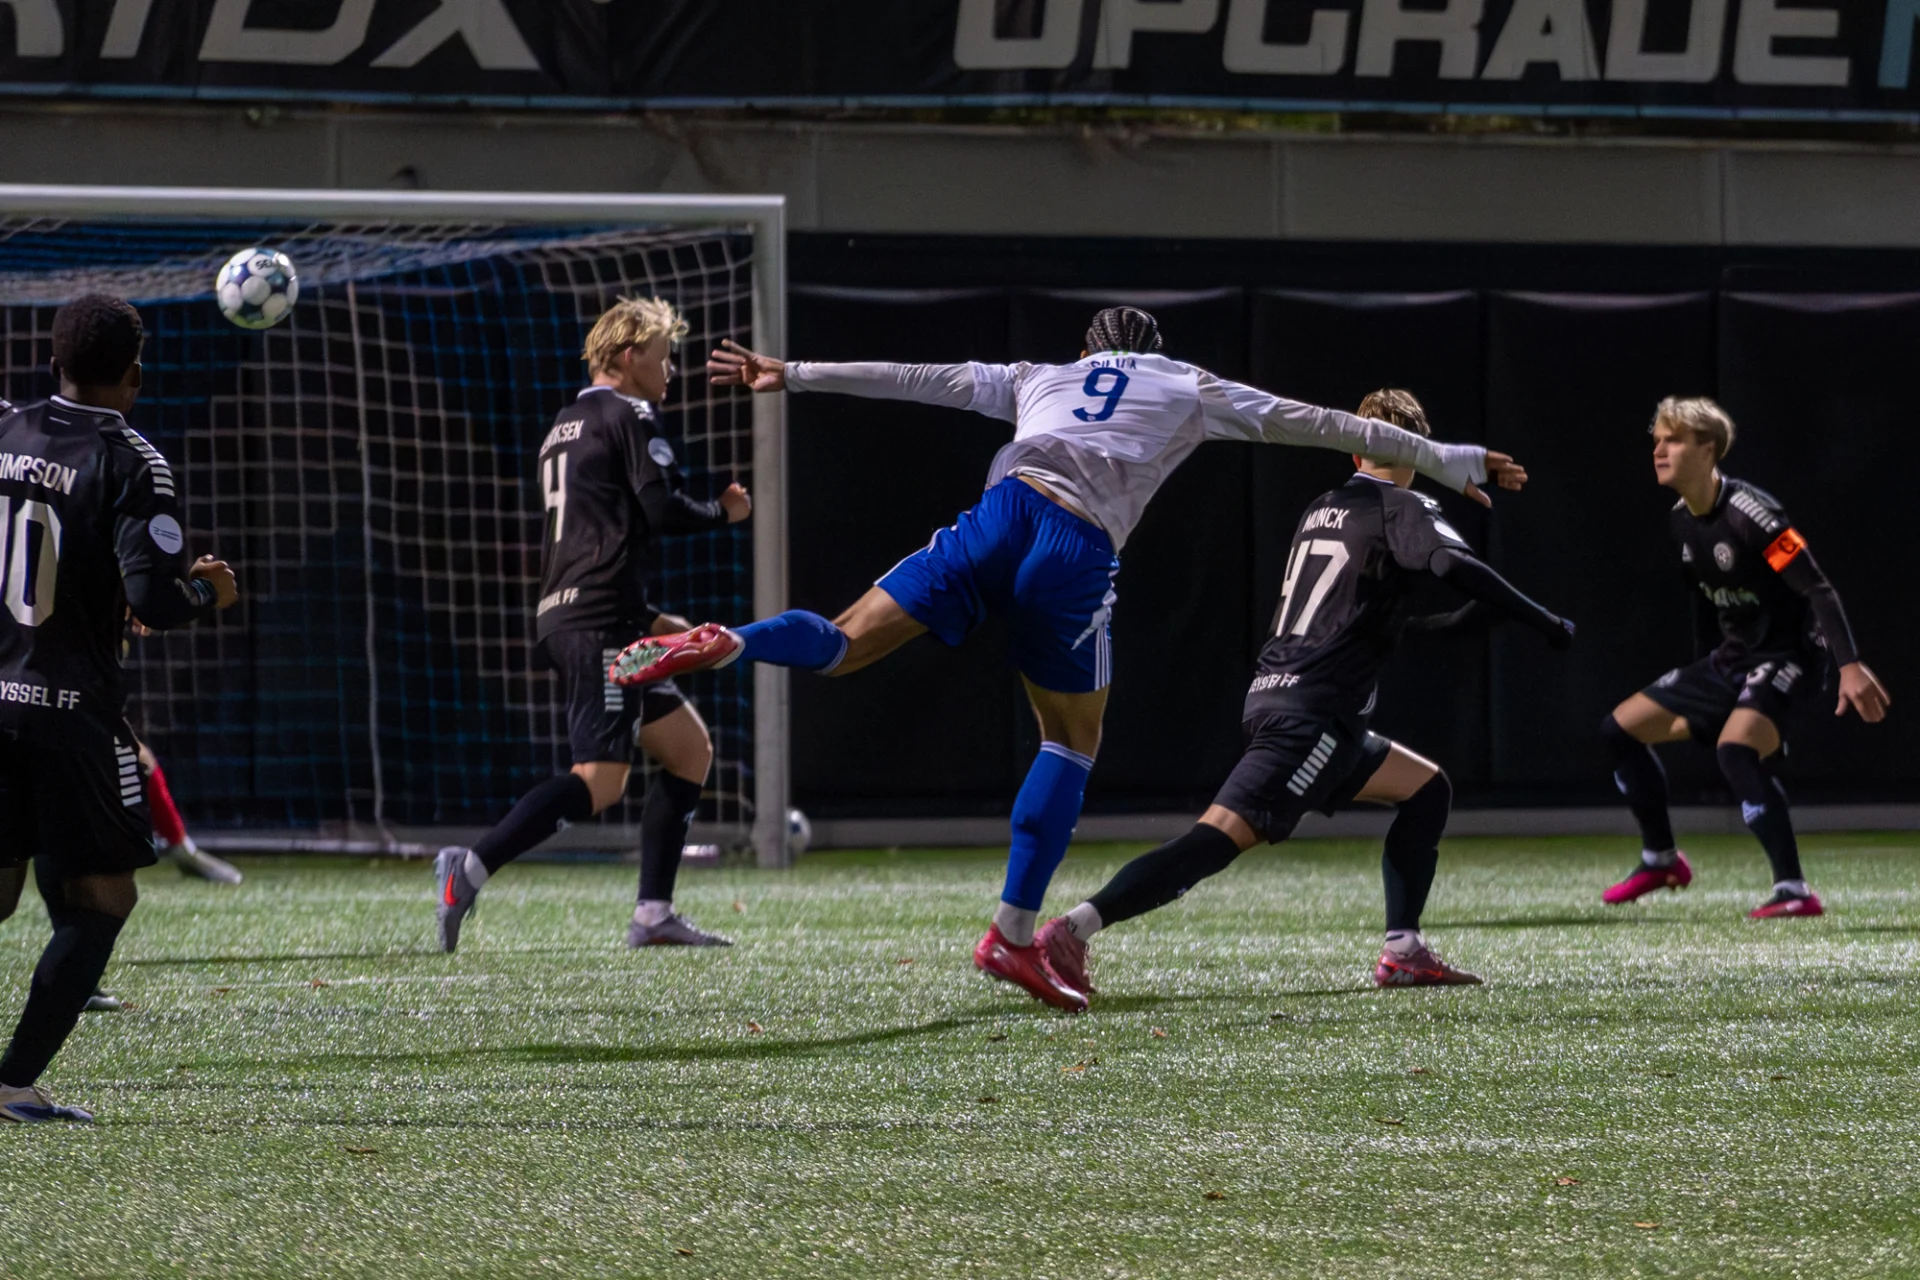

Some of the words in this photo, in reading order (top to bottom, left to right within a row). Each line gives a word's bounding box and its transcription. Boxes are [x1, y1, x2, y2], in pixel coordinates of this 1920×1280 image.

[953, 0, 1851, 88] UPGRADE
[1072, 367, 1130, 422] 9
[0, 452, 78, 495] IMPSON
[543, 452, 568, 543] 4
[56, 689, 81, 710] FF
